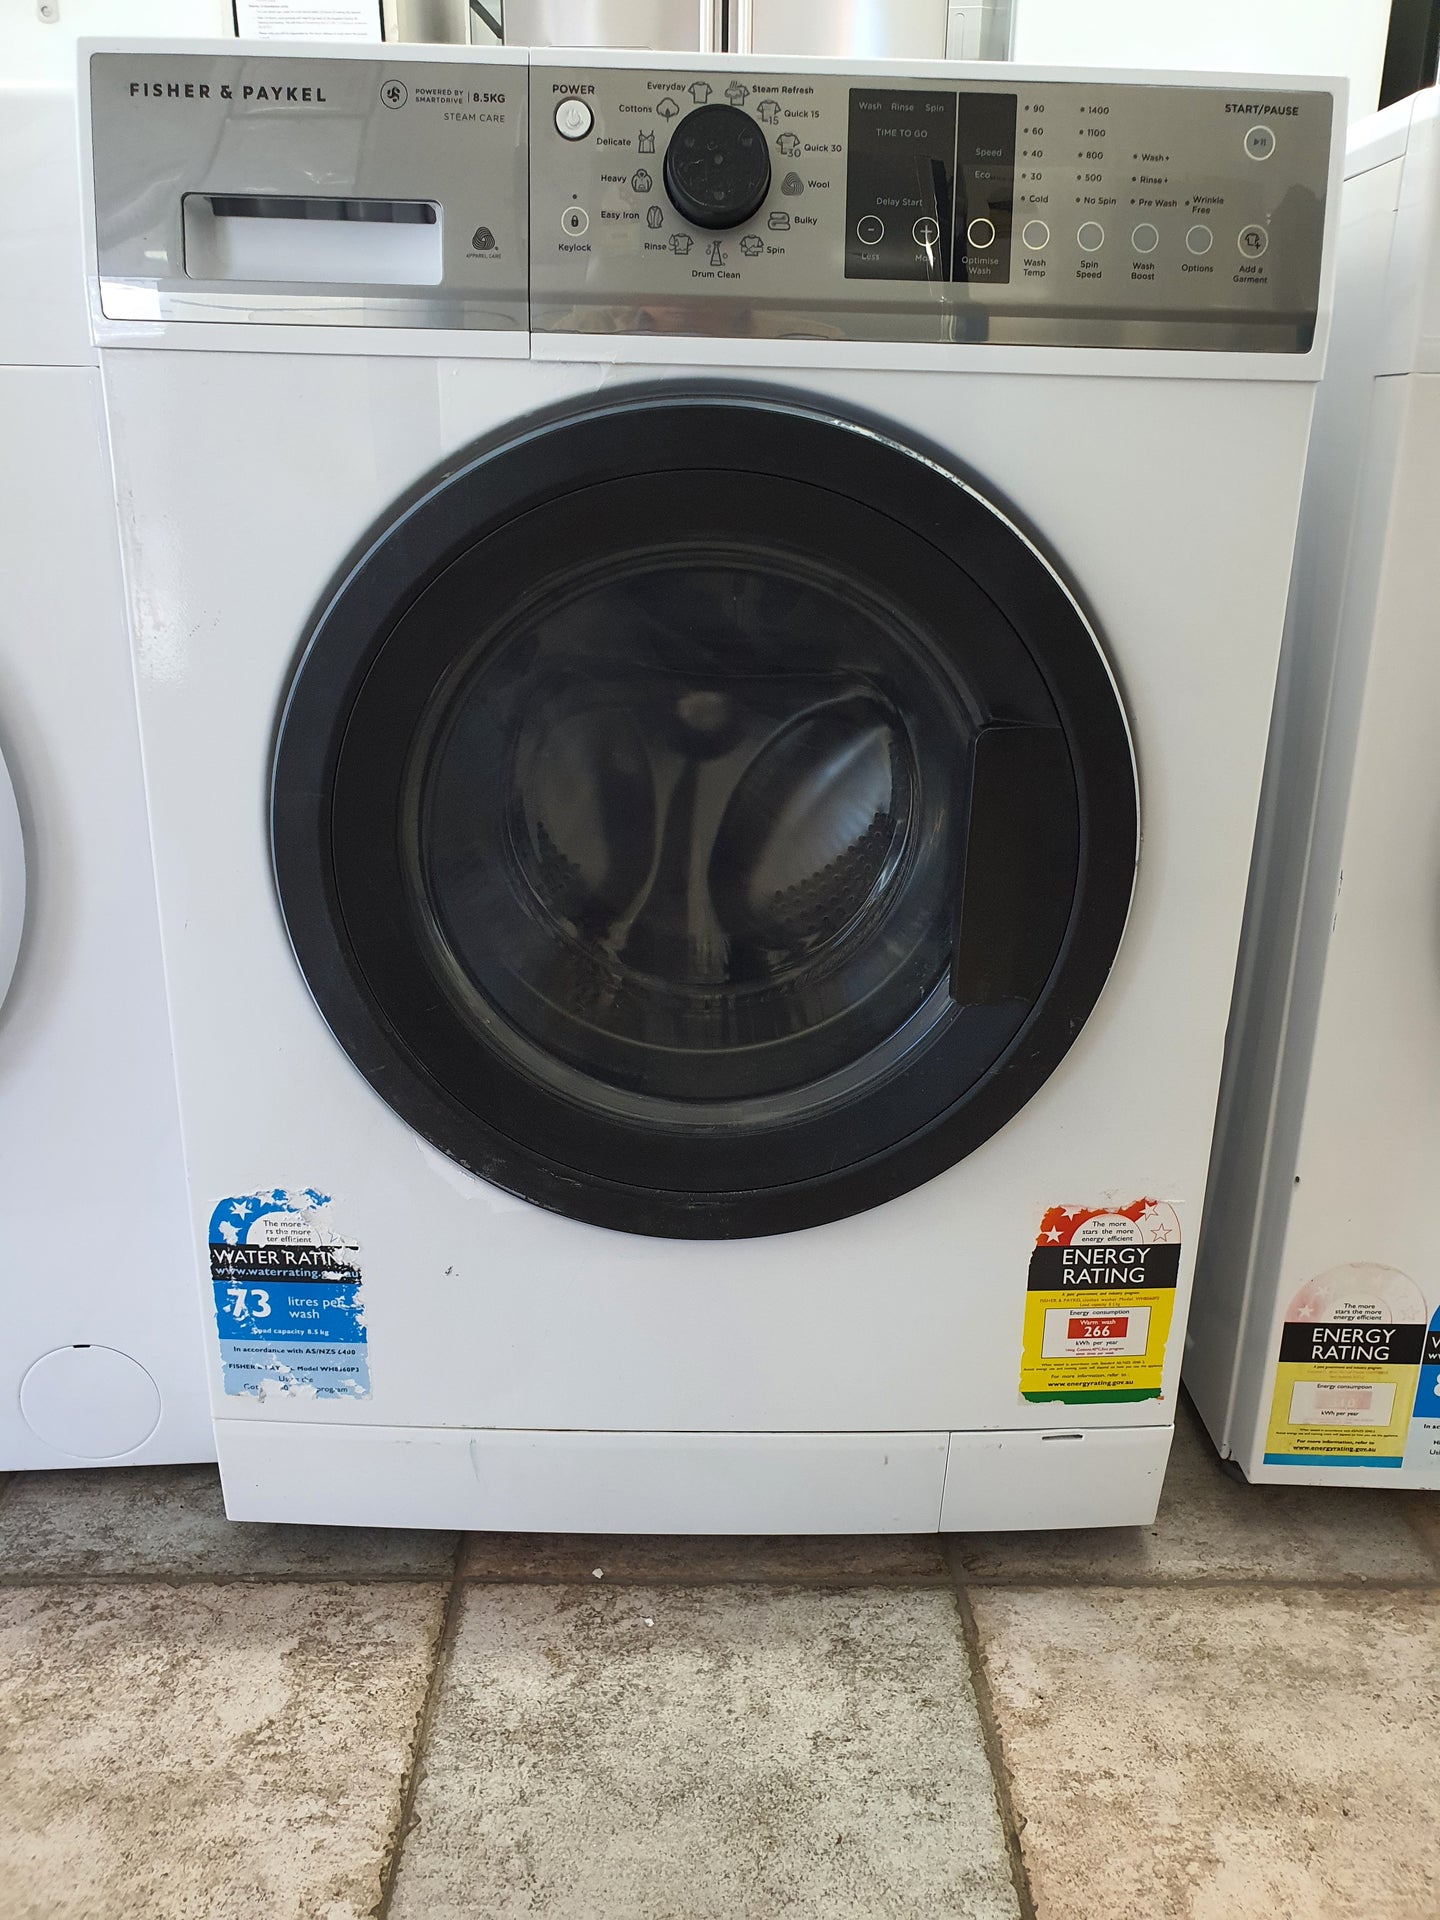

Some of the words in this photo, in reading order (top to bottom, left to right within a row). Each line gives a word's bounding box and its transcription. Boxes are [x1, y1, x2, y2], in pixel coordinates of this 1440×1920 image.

[129, 82, 210, 99] FISHER
[220, 85, 232, 99] &
[243, 86, 327, 102] PAYKEL
[552, 84, 595, 95] POWER
[647, 82, 686, 93] Everyday
[752, 85, 781, 94] Steam
[782, 86, 814, 95] Refresh
[473, 92, 505, 103] 8.5KG
[619, 104, 652, 114] Cottons
[859, 102, 882, 110] Wash
[891, 103, 914, 112] Rinse
[925, 103, 944, 113] Spin
[1033, 104, 1044, 113] 90
[1088, 105, 1109, 115] 1400
[1225, 103, 1299, 116] START/PAUSE
[444, 112, 476, 121] STEAM
[480, 114, 505, 122] CARE
[784, 109, 808, 119] Quick
[811, 110, 820, 119] 15
[876, 128, 897, 137] TIME
[900, 128, 911, 137] TO
[914, 129, 928, 138] GO
[1032, 127, 1044, 136] 60
[1087, 128, 1106, 137] 1100
[596, 137, 631, 147] Delicate
[787, 147, 801, 158] 30
[804, 143, 828, 153] Quick
[831, 143, 843, 153] 30
[975, 148, 1002, 157] Speed
[1031, 149, 1043, 158] 40
[1086, 150, 1103, 160] 800
[601, 174, 627, 185] Heavy
[975, 170, 991, 179] Eco
[1030, 172, 1042, 181] 30
[1085, 173, 1102, 182] 500
[808, 180, 830, 189] Wool
[876, 197, 899, 207] Delay
[902, 197, 923, 206] Start
[1029, 194, 1049, 203] Cold
[1083, 196, 1096, 205] No
[1099, 196, 1117, 206] Spin
[1138, 198, 1153, 207] Pre
[1155, 199, 1177, 207] Wash
[1193, 195, 1225, 204] Wrinkle
[1192, 206, 1211, 214] Free
[601, 210, 620, 221] Easy
[623, 211, 640, 220] Iron
[794, 216, 818, 226] Bulky
[558, 243, 591, 253] Keylock
[644, 242, 667, 251] Rinse
[766, 245, 786, 255] Spin
[861, 253, 880, 261] Less
[961, 256, 999, 266] Optimise
[1023, 258, 1046, 267] Wash
[1080, 260, 1099, 270] Spin
[1132, 262, 1155, 270] Wash
[969, 267, 991, 275] Wash
[1181, 263, 1214, 273] Options
[1239, 264, 1255, 273] Add
[692, 269, 715, 279] Drum
[717, 270, 741, 279] Clean
[1023, 269, 1046, 278] Temp
[1076, 270, 1102, 280] Speed
[1131, 271, 1155, 280] Boost
[1233, 274, 1268, 284] Garment
[263, 1219, 279, 1227] The
[1093, 1220, 1106, 1228] The
[213, 1249, 281, 1265] WATER
[284, 1251, 344, 1266] RATIN
[1062, 1248, 1151, 1266] ENERGY
[1063, 1267, 1146, 1285] RATING
[227, 1289, 272, 1318] 73
[288, 1296, 319, 1307] litres
[289, 1309, 320, 1320] wash
[1070, 1310, 1089, 1318] Energy
[252, 1328, 272, 1336] oad
[273, 1328, 305, 1337] capacity
[320, 1330, 330, 1338] kg
[1084, 1326, 1110, 1337] 266
[1312, 1328, 1396, 1344] ENERGY
[1311, 1345, 1390, 1361] RATING
